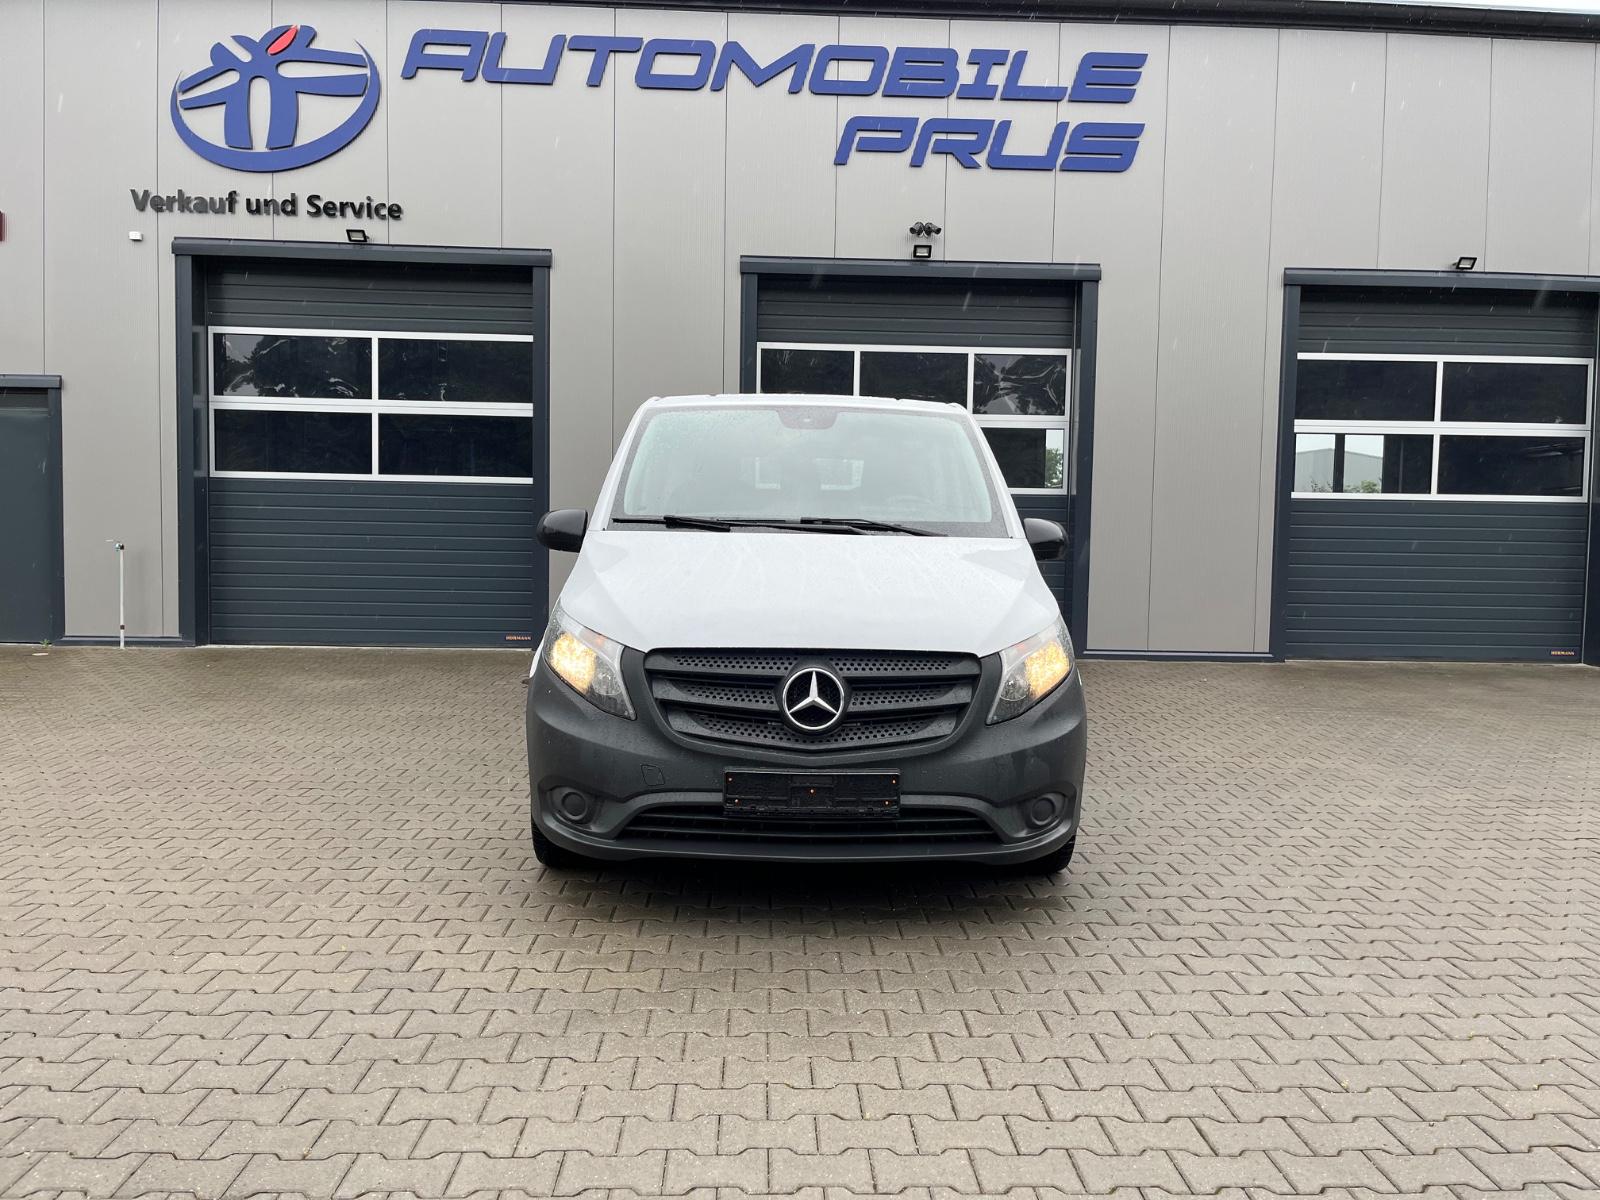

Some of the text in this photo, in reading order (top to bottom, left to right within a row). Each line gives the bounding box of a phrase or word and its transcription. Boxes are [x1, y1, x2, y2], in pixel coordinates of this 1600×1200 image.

[401, 29, 1148, 104] AUTOMOBILE
[834, 116, 1145, 173] PRUS
[130, 188, 403, 221] Verkauf und Service
